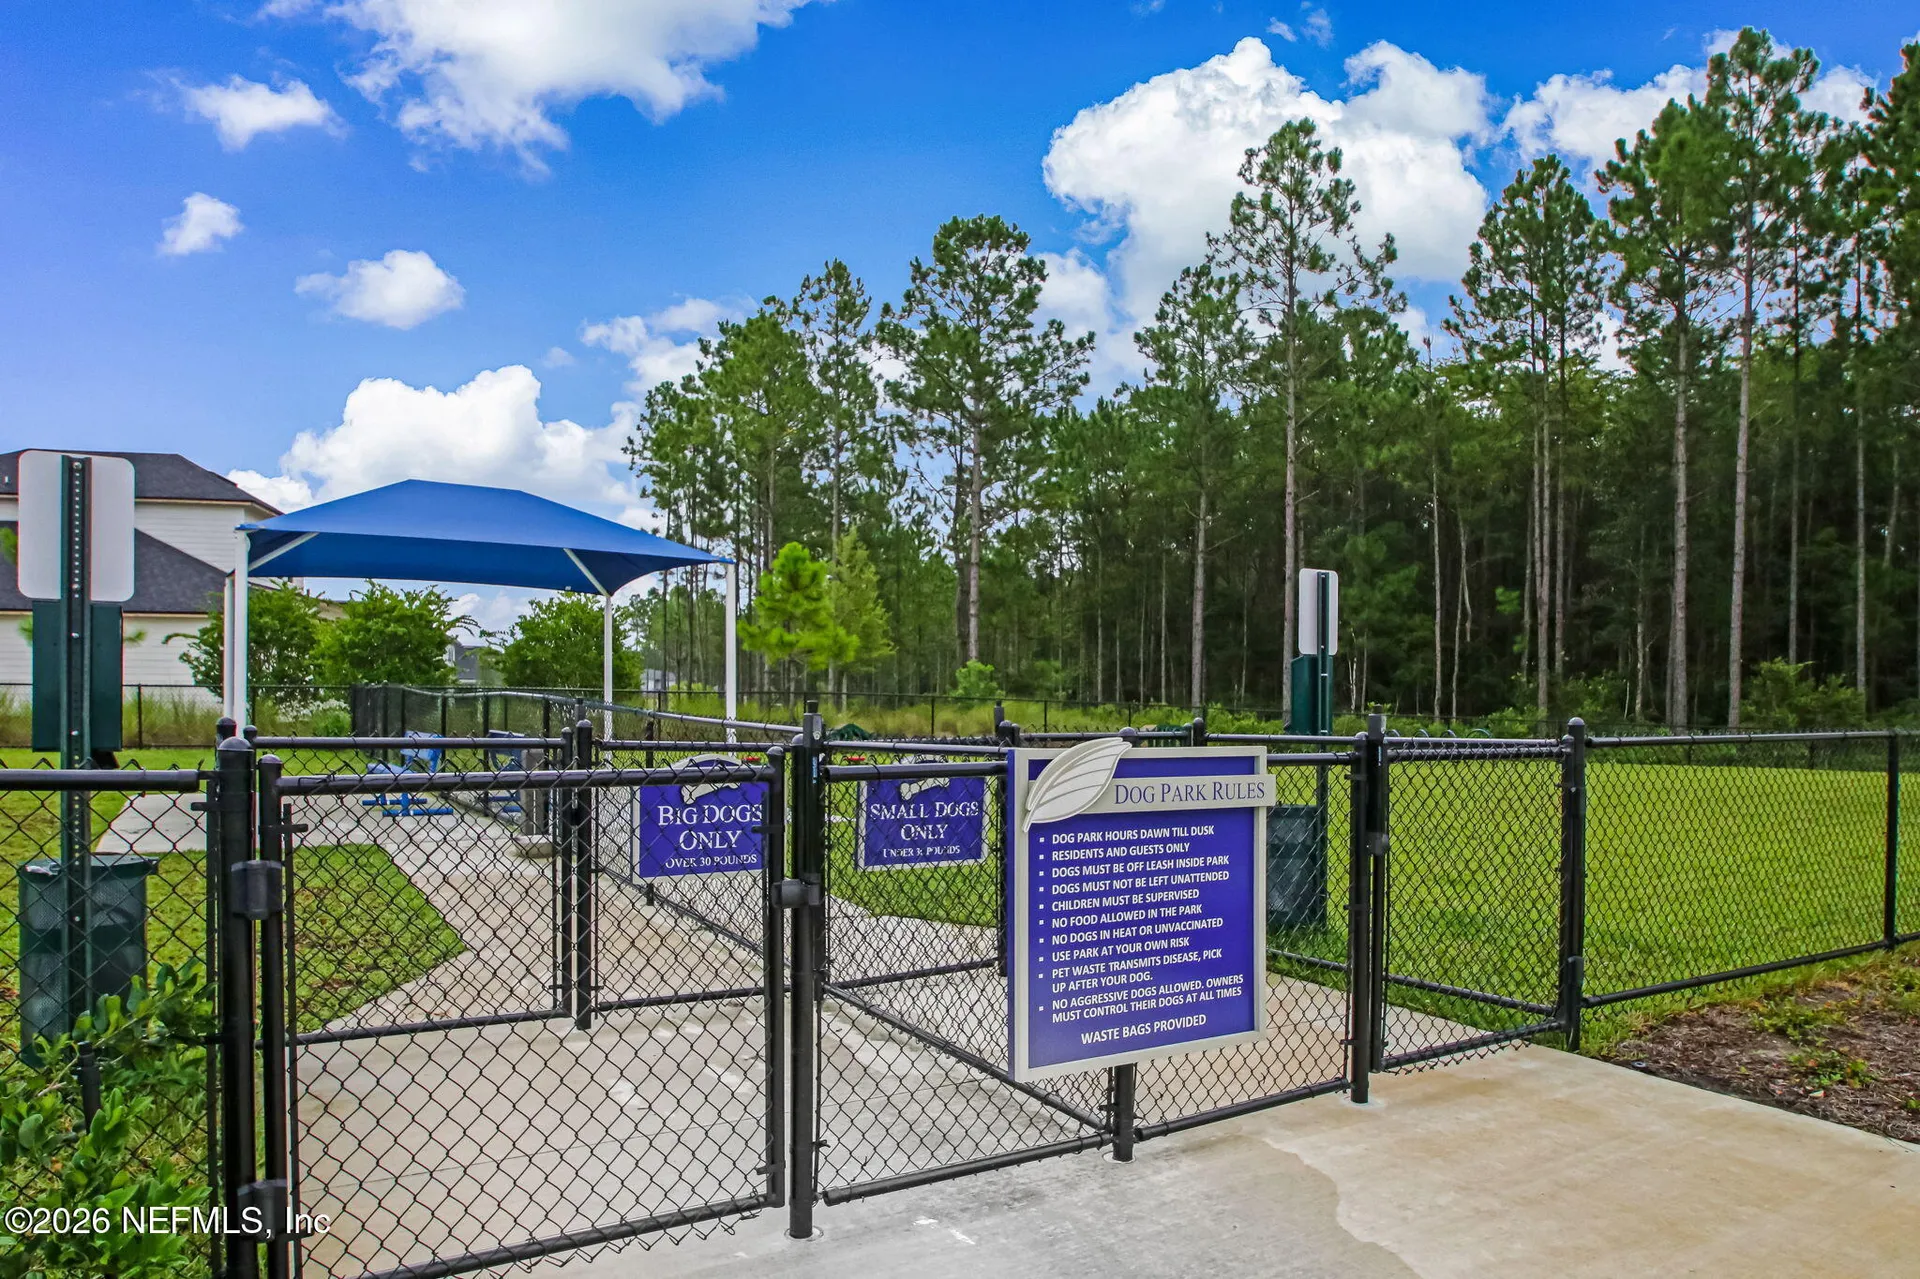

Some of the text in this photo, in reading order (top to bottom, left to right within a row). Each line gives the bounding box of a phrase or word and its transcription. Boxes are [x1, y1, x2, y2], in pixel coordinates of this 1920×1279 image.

[1115, 782, 1265, 804] DOG PARK RULES
[658, 805, 762, 825] BIG DOGS
[871, 802, 978, 820] SMALL DOGS
[679, 830, 742, 850] ONLY
[901, 824, 948, 840] ONLY
[1052, 825, 1214, 844] DOG PARK HOURS DAWN TILL DUSK
[665, 858, 696, 868] OVER
[714, 854, 757, 865] POUNDS
[1052, 843, 1190, 860] RESIDENTS AND GUESTS ONLY
[1052, 856, 1229, 878] DOGS MUST BE OFF LEASH INSIDE PARK
[1052, 871, 1229, 894] DOGS MUST NOT BE LEFT UNATTENDED
[1052, 889, 1199, 912] CHILDREN MUST BE SUPERVISED
[1052, 905, 1202, 928] NO FOOD ALLOWED IN THE PARK
[1052, 918, 1223, 945] NO DOGS IN HEAT OR UNVACCINATED
[1052, 937, 1190, 962] USE PARK AT YOUR OWN RISK
[1052, 949, 1222, 978] PET WASTE TRANSMITS DISEASE, PICK
[1052, 971, 1153, 993] UP AFTER YOUR DOG.
[1052, 974, 1244, 1010] NO AGGRESSIVE DOGS ALLOWED. OWNERS
[1052, 987, 1241, 1023] MUST CONTROL THEIR DOGS AT ALL TIMES
[1081, 1014, 1206, 1044] WASTE BAGS PROVIDED
